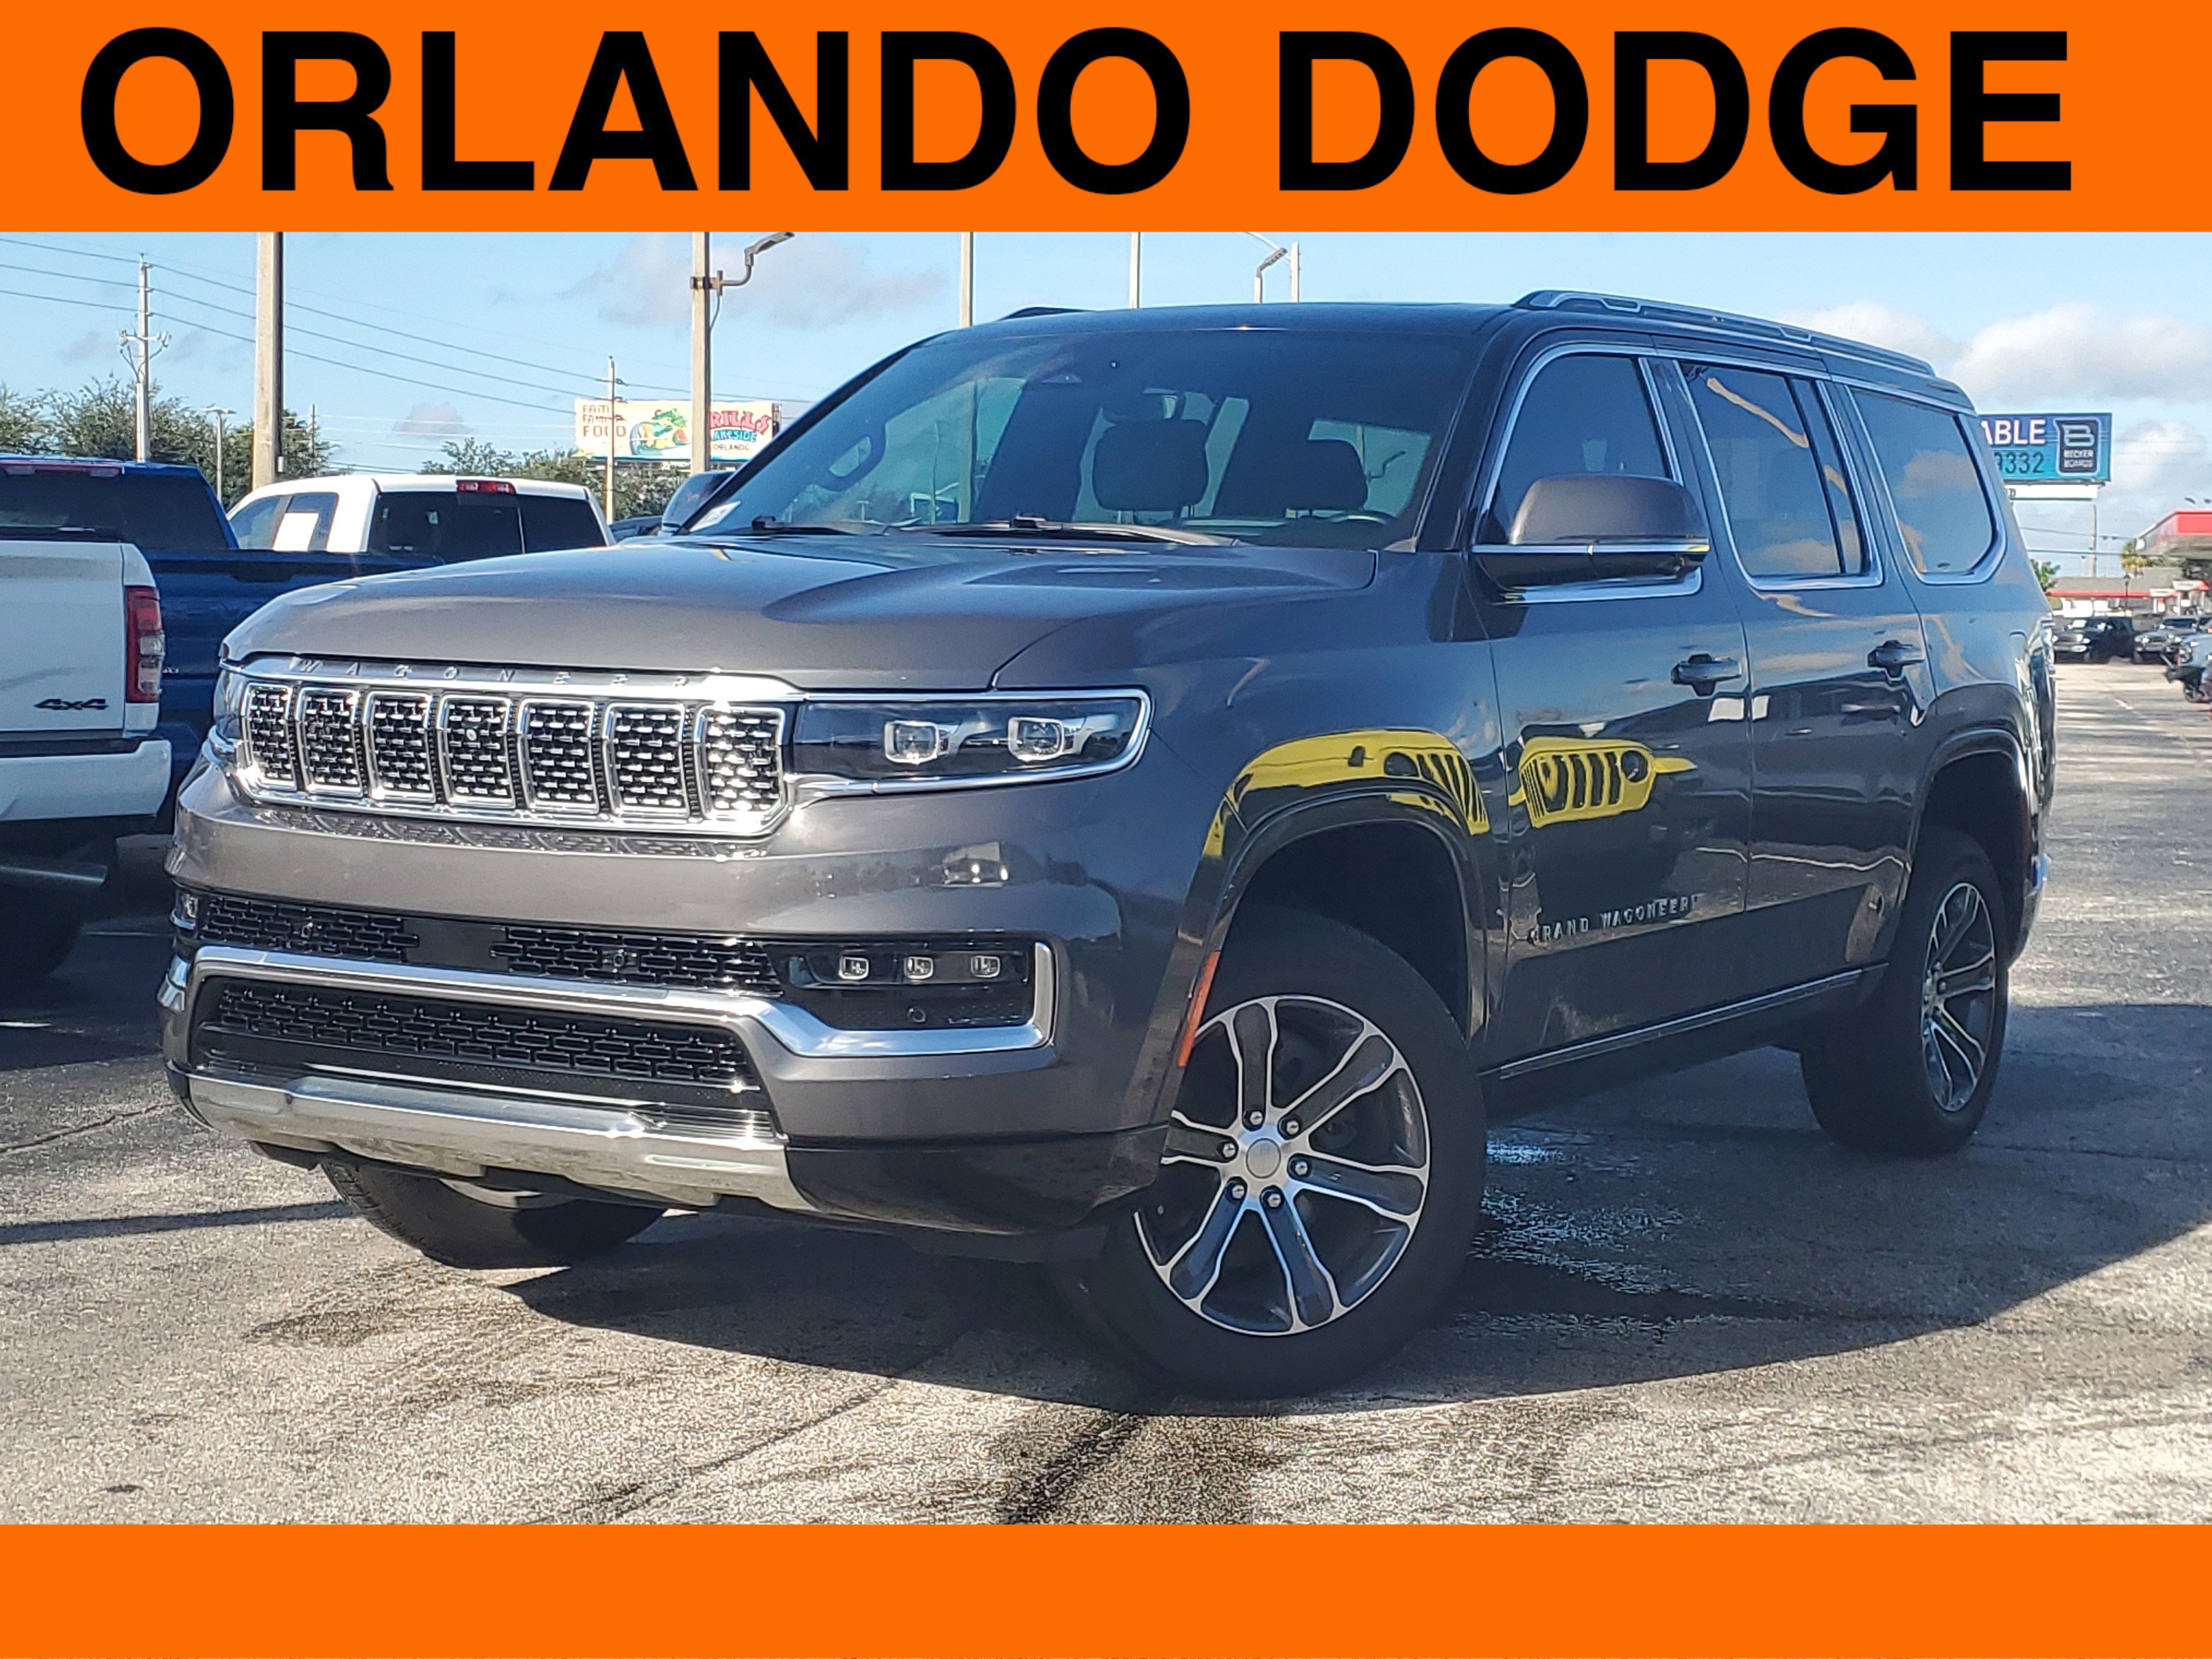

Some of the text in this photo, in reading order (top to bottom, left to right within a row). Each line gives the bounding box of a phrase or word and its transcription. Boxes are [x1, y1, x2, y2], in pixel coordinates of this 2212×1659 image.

[710, 410, 772, 435] RILLS
[712, 429, 757, 442] AKESIDE
[33, 698, 109, 710] 4x4
[1531, 896, 1689, 943] GRAND WAGONEER
